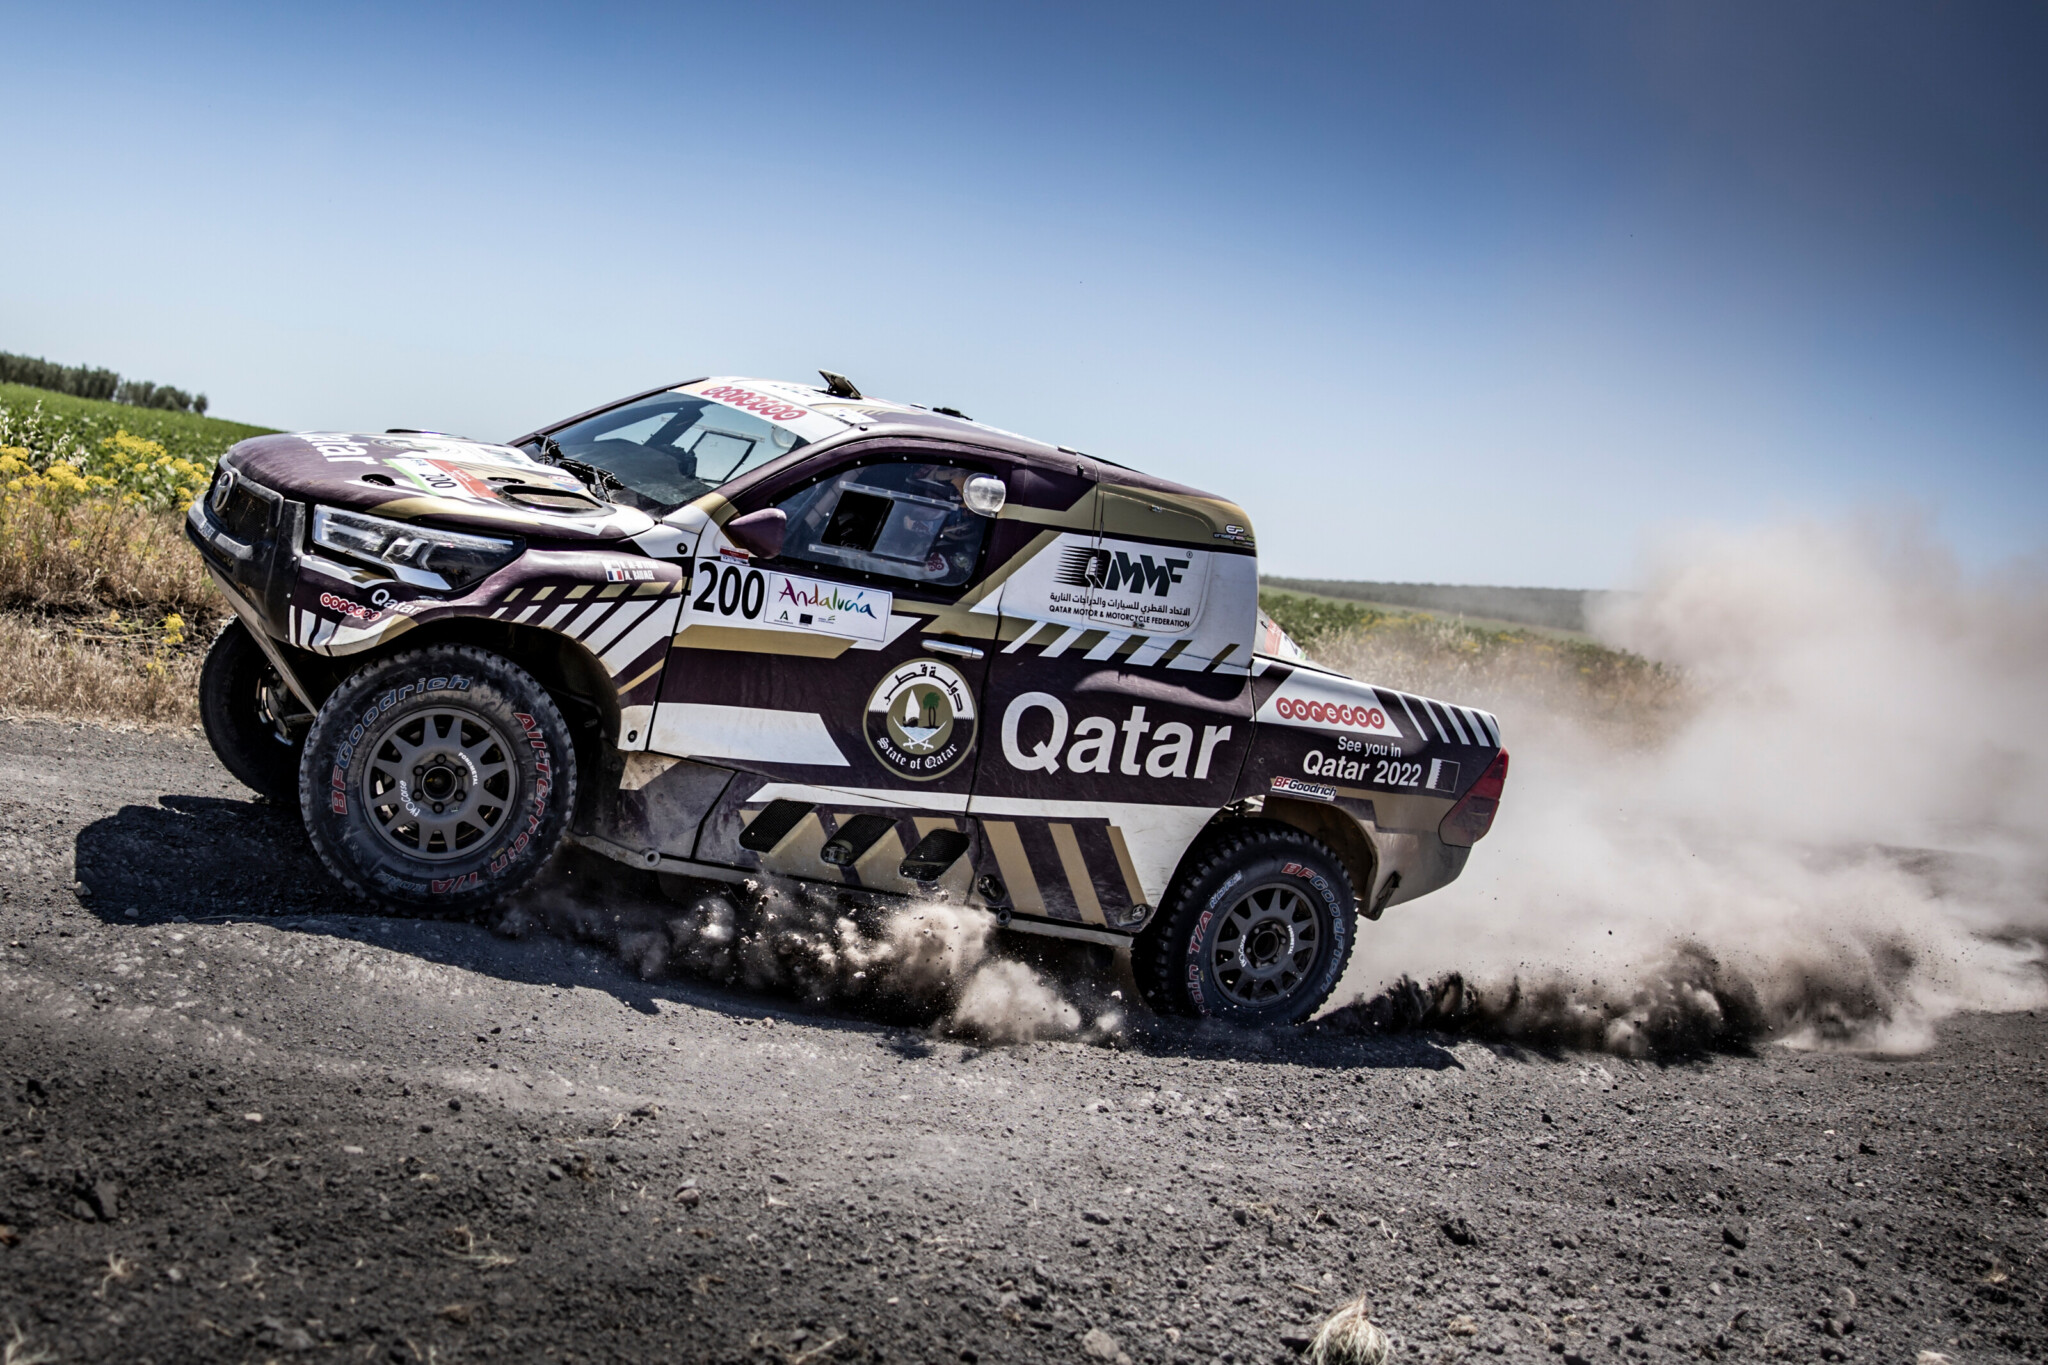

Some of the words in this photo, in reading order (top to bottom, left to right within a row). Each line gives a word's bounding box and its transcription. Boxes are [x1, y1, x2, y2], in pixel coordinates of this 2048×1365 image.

[292, 434, 379, 465] atar
[321, 592, 382, 622] ooredoo
[371, 588, 424, 615] Qatar
[693, 561, 765, 620] 200
[778, 577, 877, 620] Andalucía
[1049, 604, 1072, 614] QATAR
[1073, 608, 1098, 617] MOTOR
[1099, 610, 1104, 618] &
[1105, 611, 1151, 624] MOTORCYCLE
[1151, 616, 1190, 628] FEDERATION
[1276, 697, 1385, 730] ooredoo
[332, 674, 475, 815] BFGoodrich
[1001, 691, 1233, 779] Qatar
[1337, 735, 1362, 752] See
[1365, 741, 1388, 757] you
[1390, 745, 1401, 758] in
[877, 737, 907, 766] State
[910, 757, 921, 770] of
[924, 743, 958, 769] Qatar
[1303, 749, 1371, 783] Qatar
[1373, 759, 1422, 787] 2022
[1273, 776, 1337, 798] BFGoodrich
[1188, 910, 1214, 955] T/A
[1281, 862, 1345, 993] BFGoodrich
